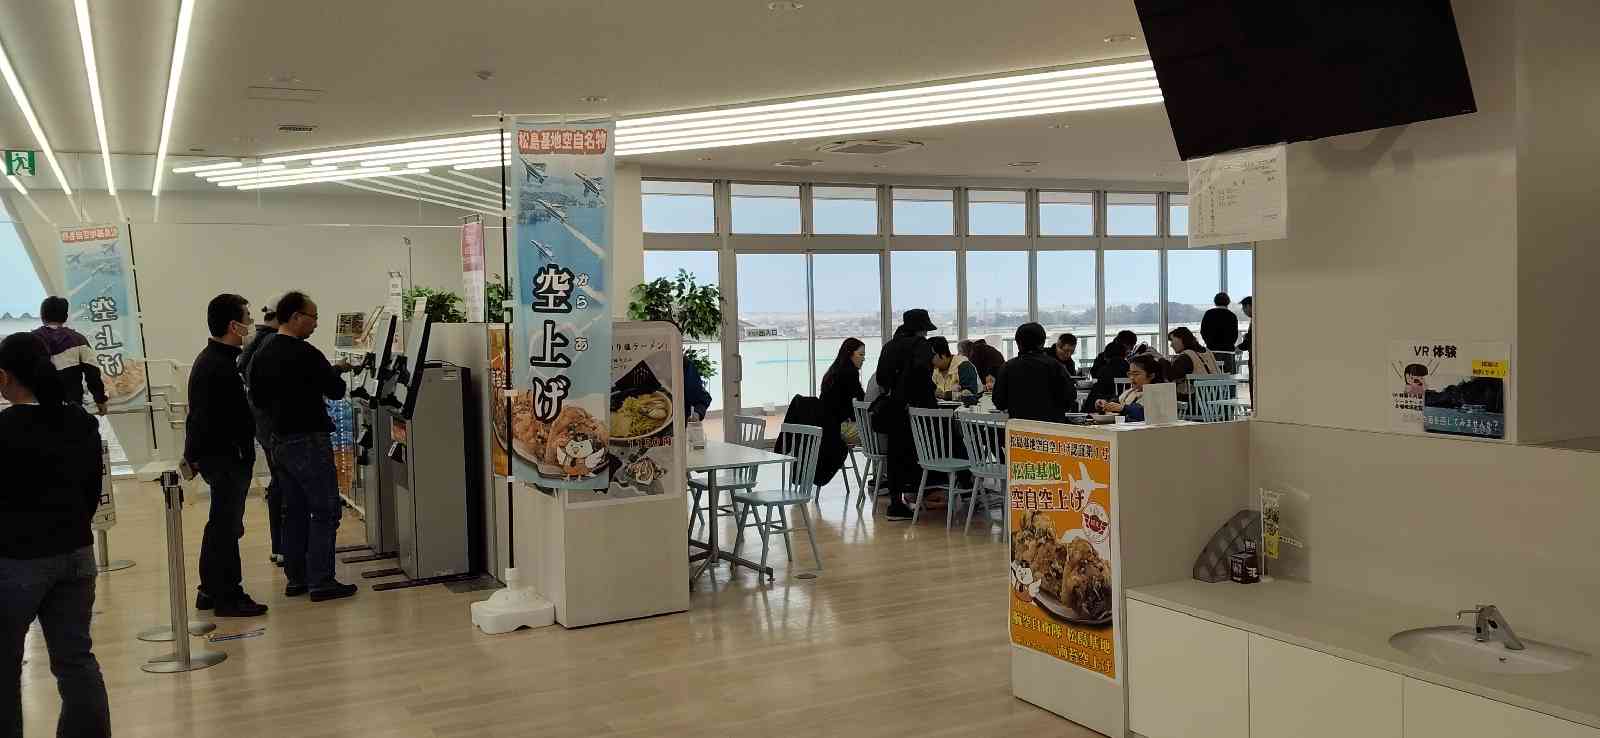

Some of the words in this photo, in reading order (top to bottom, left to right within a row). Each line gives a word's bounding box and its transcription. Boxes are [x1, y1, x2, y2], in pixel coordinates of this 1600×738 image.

[519, 130, 607, 150] 松島基地空自名物
[531, 264, 571, 423] 空上げ
[1414, 346, 1429, 357] VR
[1433, 345, 1457, 358] 体験
[1011, 460, 1062, 480] 松島基地
[1011, 487, 1085, 512] 空自空上げ
